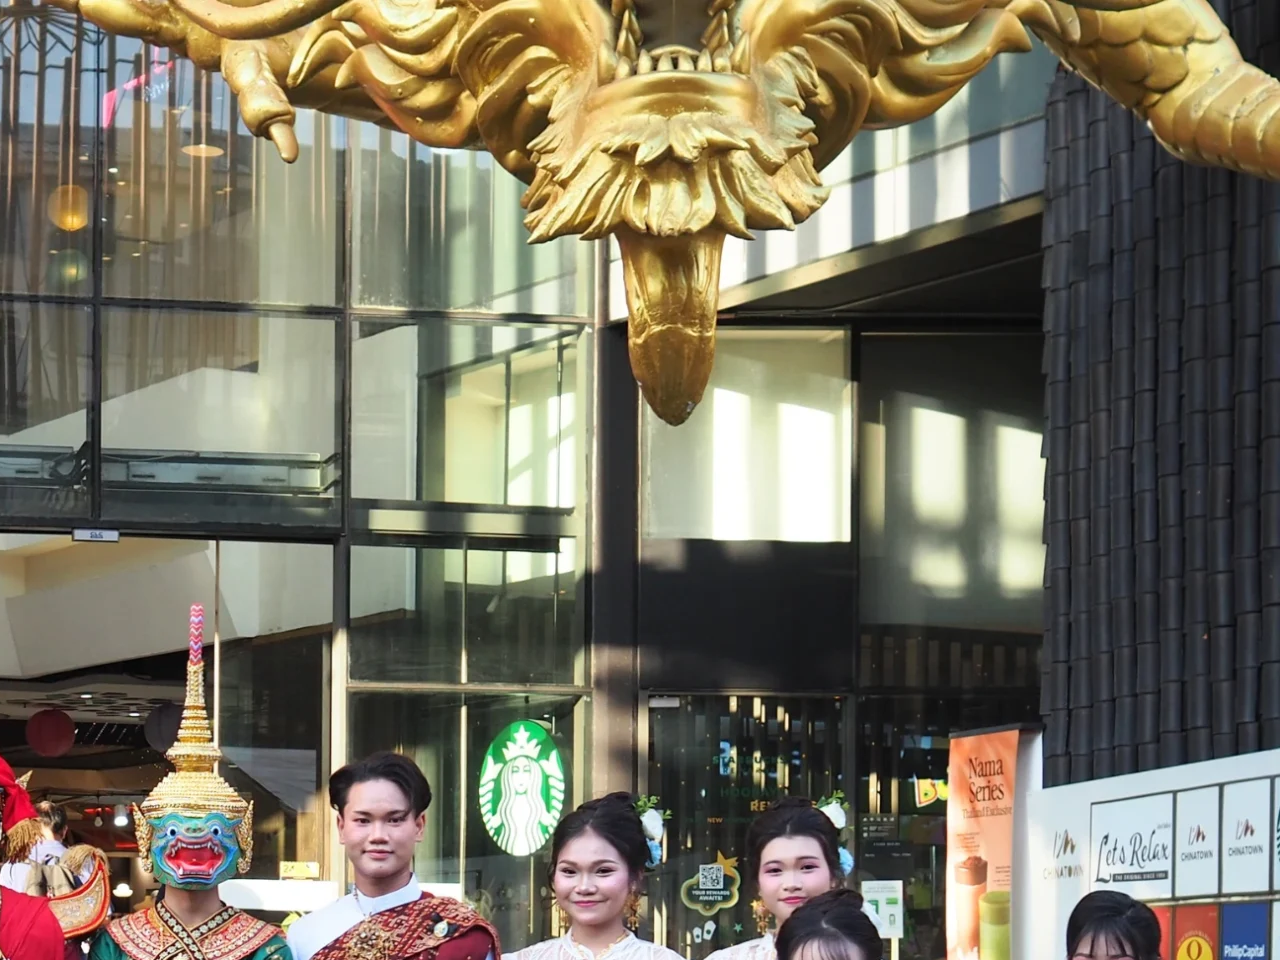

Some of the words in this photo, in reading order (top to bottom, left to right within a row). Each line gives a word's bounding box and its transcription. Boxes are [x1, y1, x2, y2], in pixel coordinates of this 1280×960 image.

[968, 757, 1004, 779] Nama
[968, 780, 1004, 804] Series
[1128, 829, 1170, 869] Relax
[1181, 850, 1213, 862] CHINATOWN
[1228, 844, 1263, 857] CHINATOWN
[1043, 864, 1084, 879] CHINATOWN
[1224, 944, 1265, 960] PhillipCapital
